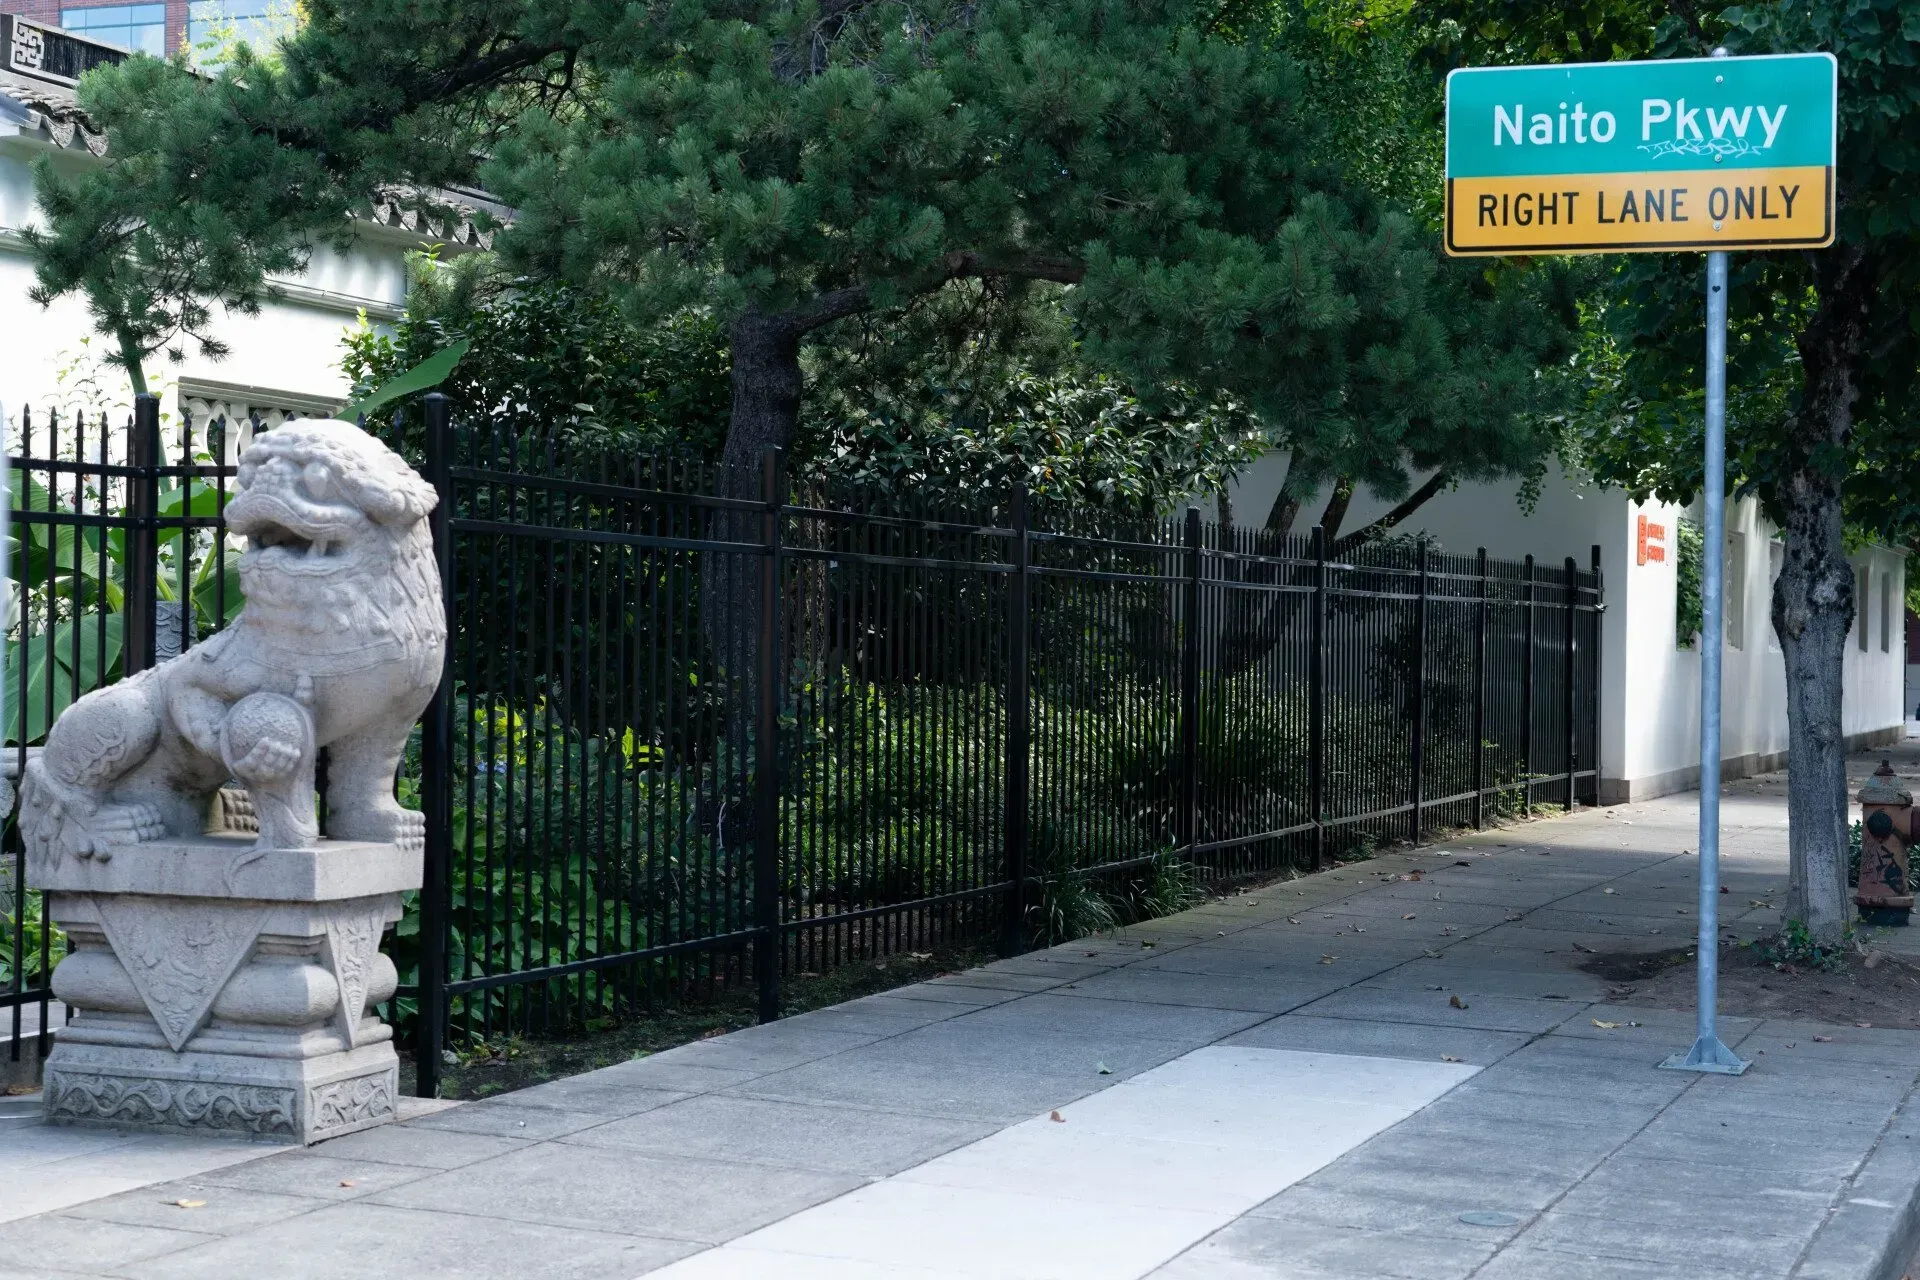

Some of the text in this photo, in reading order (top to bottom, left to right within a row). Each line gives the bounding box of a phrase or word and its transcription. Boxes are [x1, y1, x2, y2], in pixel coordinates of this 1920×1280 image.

[1493, 97, 1788, 148] Naito Pkwy
[1478, 184, 1801, 227] RIGHT LANE ONLY
